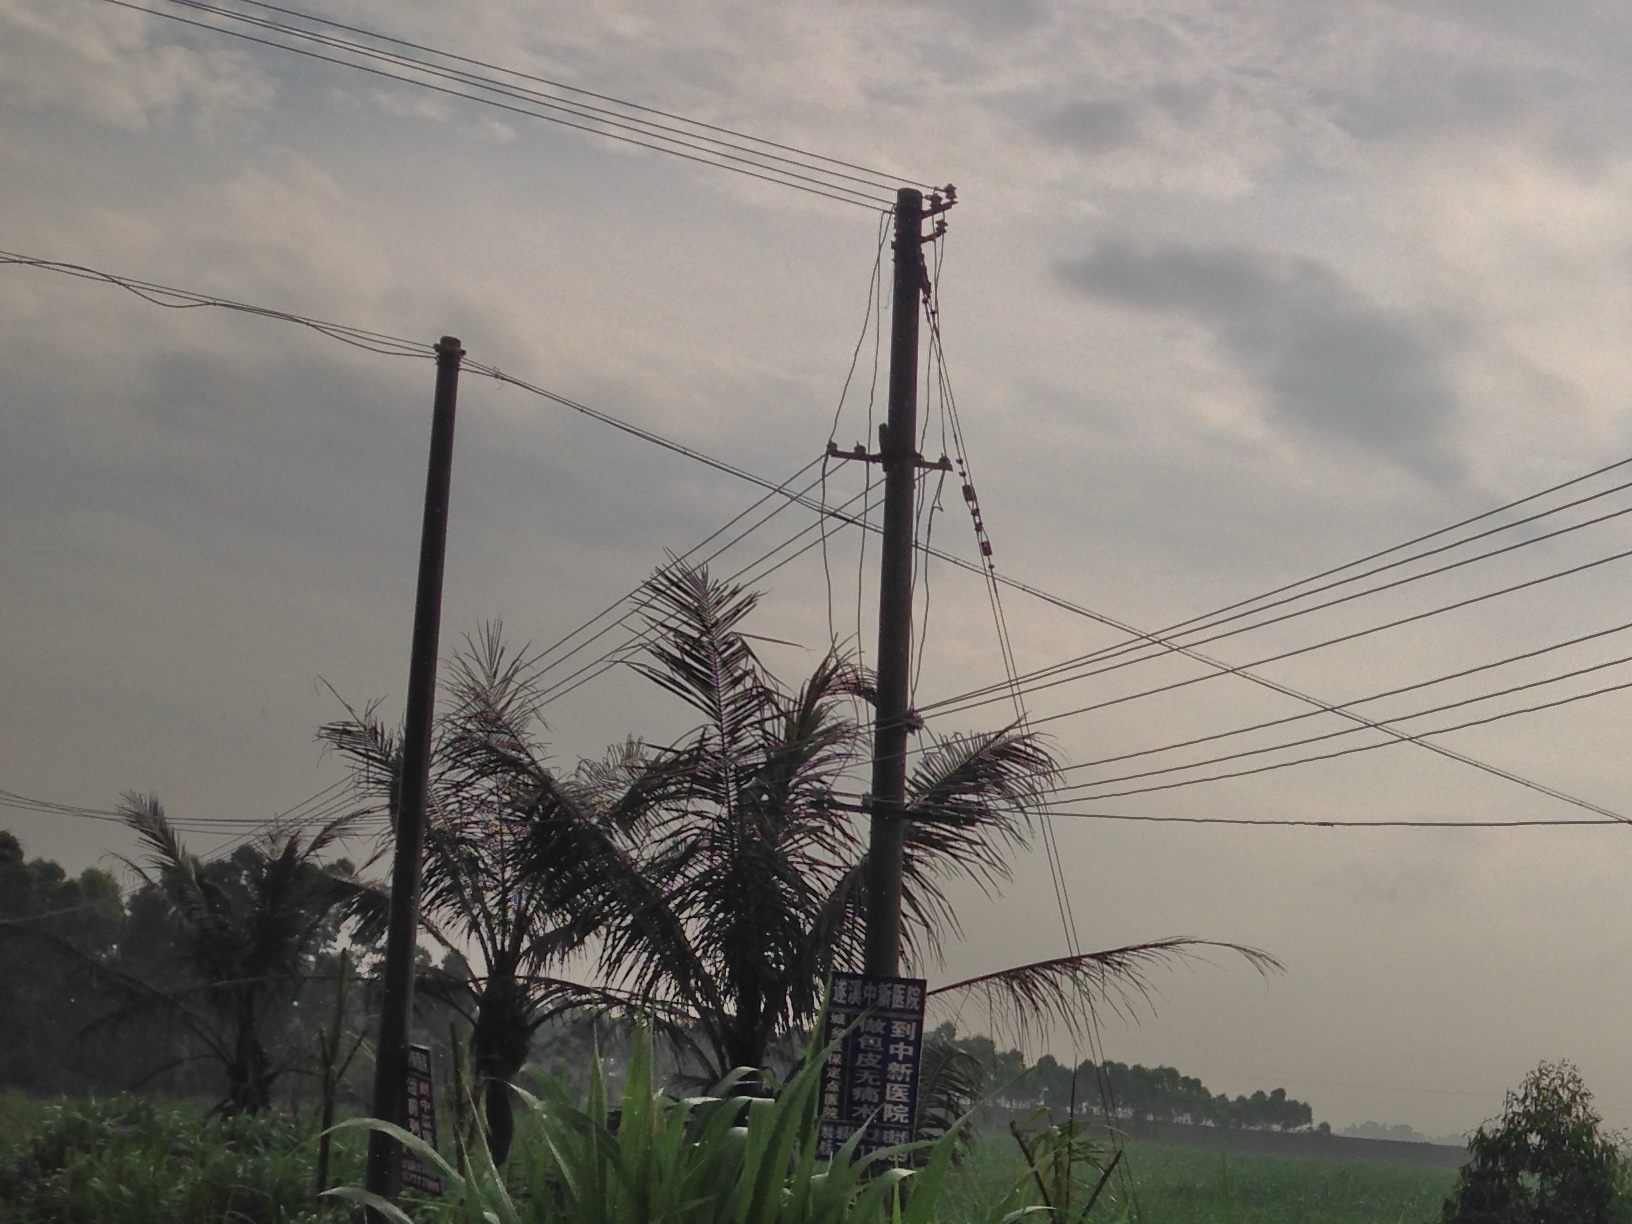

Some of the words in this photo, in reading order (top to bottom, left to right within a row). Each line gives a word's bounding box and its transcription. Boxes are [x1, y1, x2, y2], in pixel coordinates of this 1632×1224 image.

[851, 1017, 887, 1120] 做包皮无痛术
[882, 1020, 917, 1124] 到中新医院
